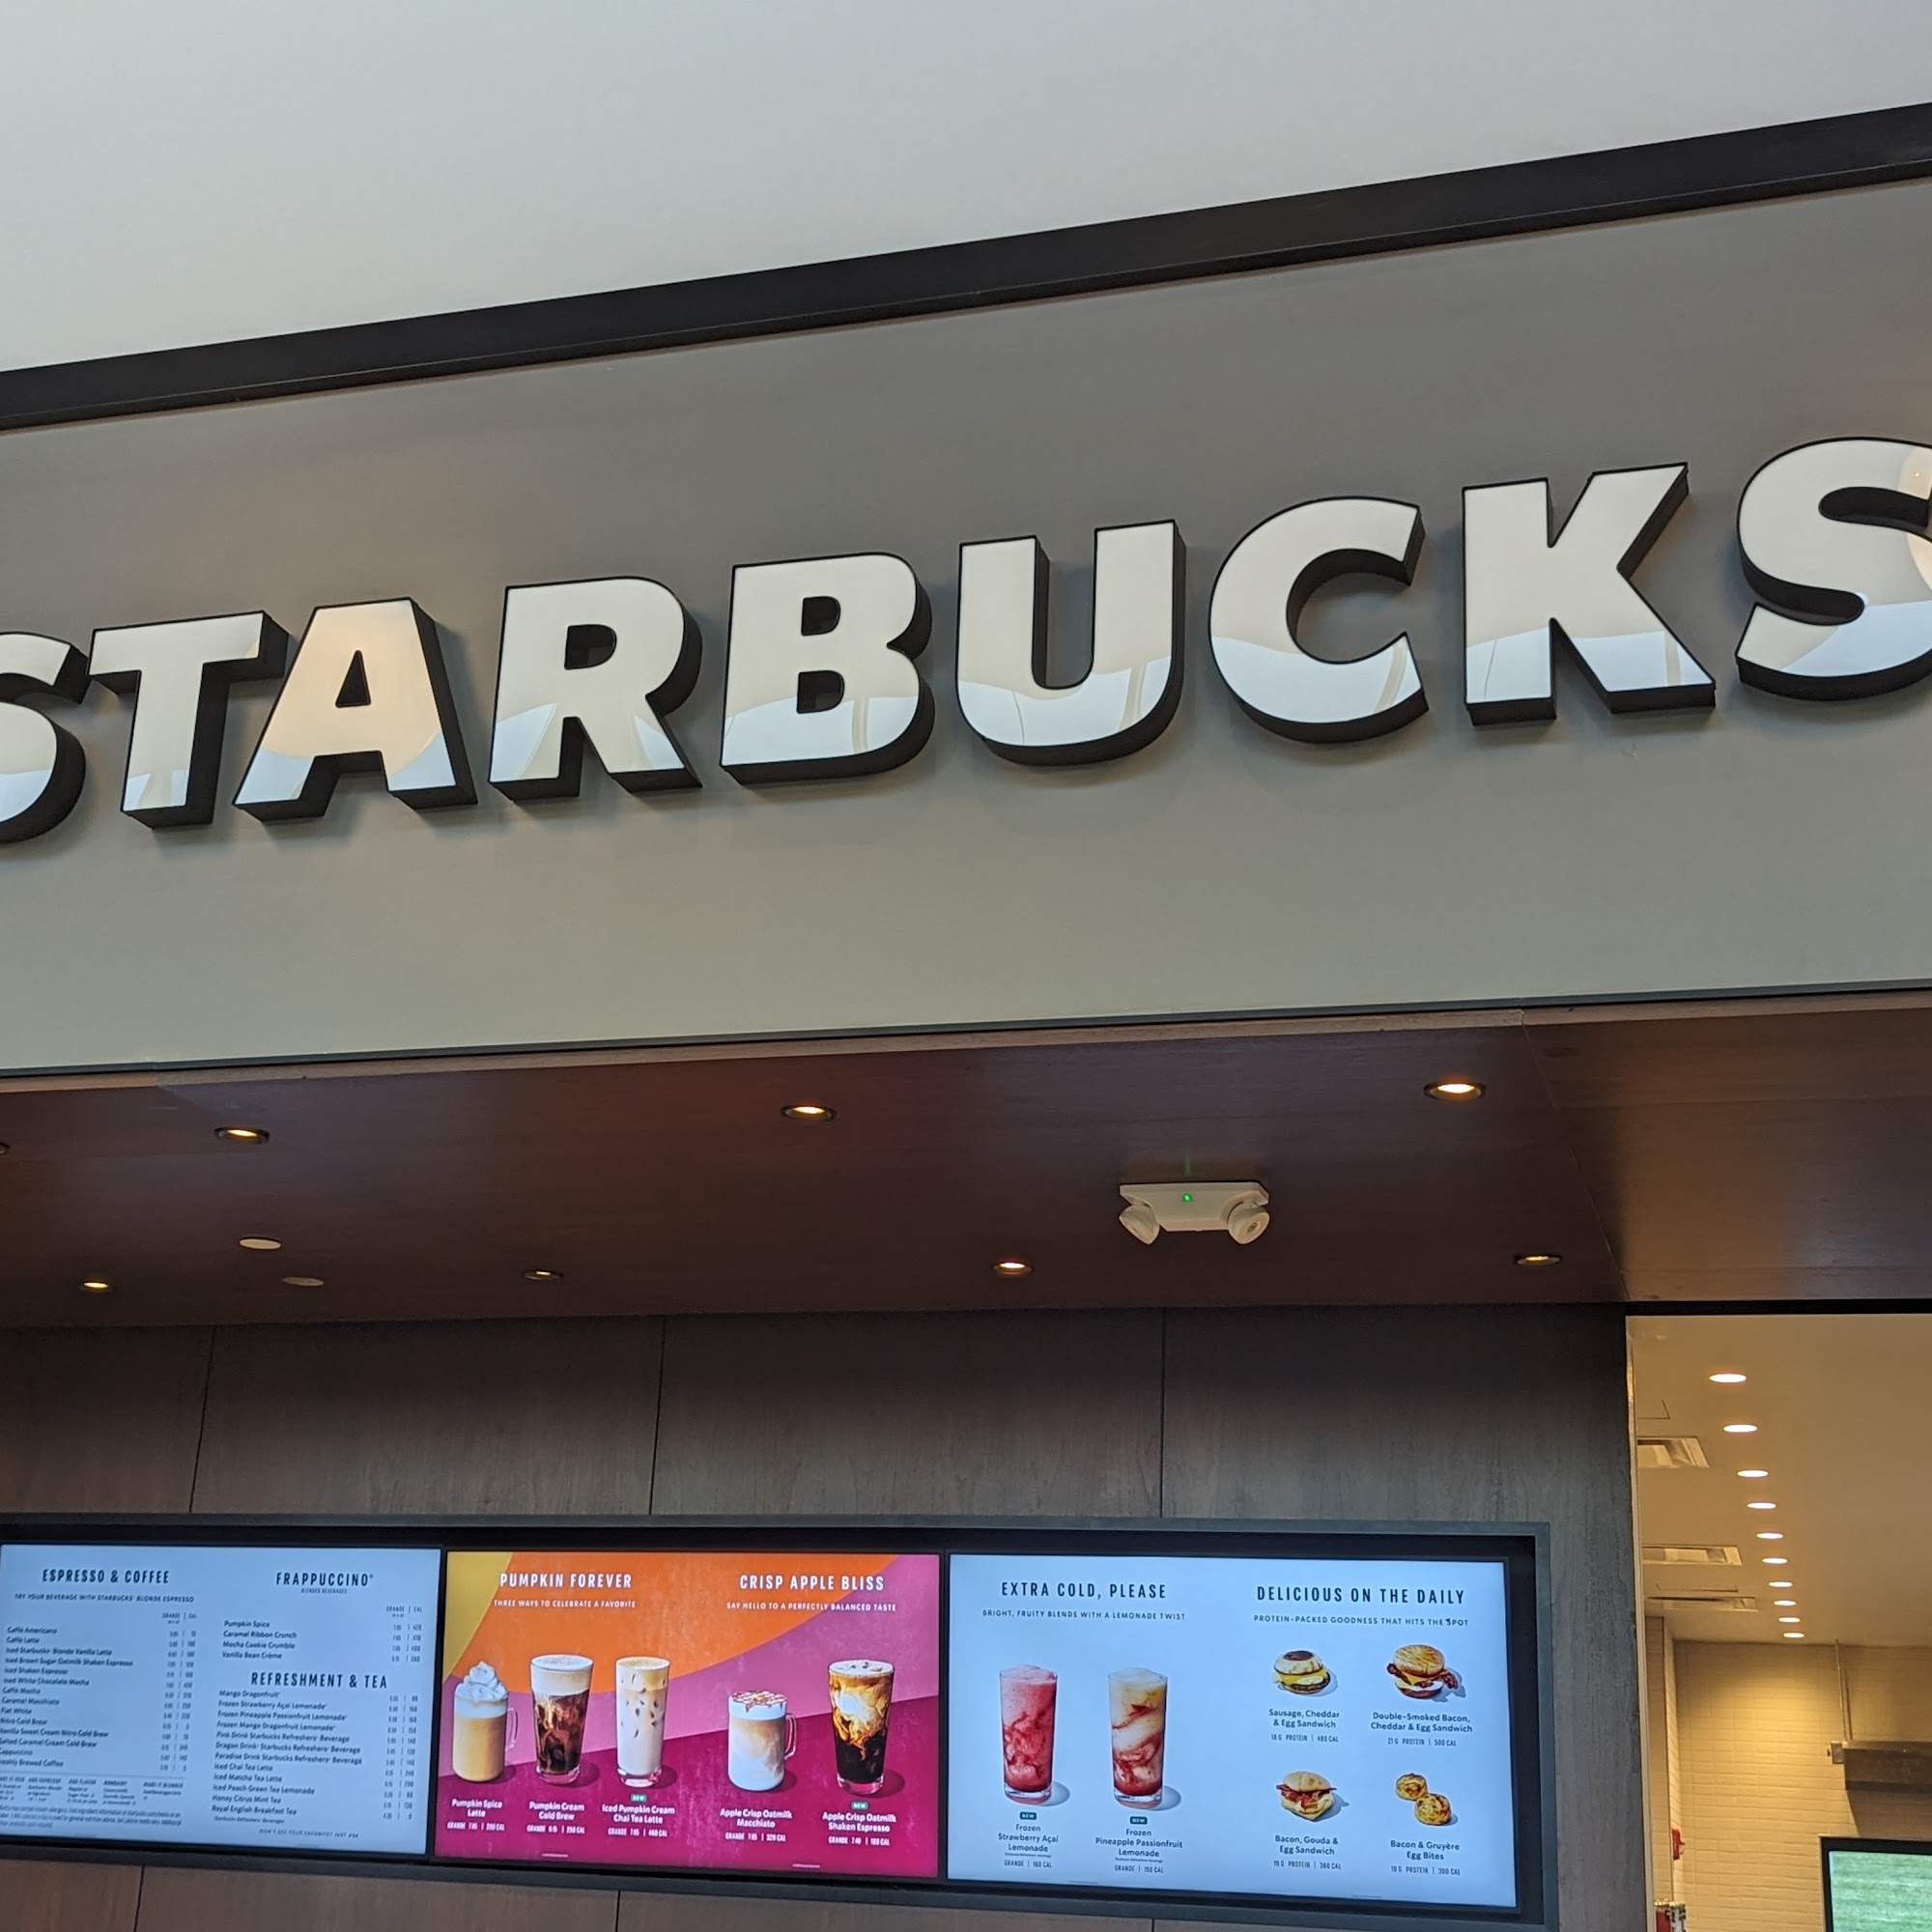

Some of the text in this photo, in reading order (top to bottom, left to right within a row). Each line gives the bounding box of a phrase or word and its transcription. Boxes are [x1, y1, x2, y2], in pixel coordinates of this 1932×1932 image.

[43, 1569, 168, 1583] ESPRESSO & COFFEE
[500, 1573, 631, 1588] PUMPKIN FOREVER
[740, 1575, 883, 1590] CRISP APPLE BLISS
[1002, 1582, 1165, 1599] EXTRA COLD, PLEASE
[1257, 1586, 1463, 1604] DELICIOUS ON THE DAILY
[251, 1672, 386, 1688] REFRESHMENT & TEA
[1269, 1709, 1304, 1718] Sausage,
[1373, 1712, 1470, 1723] Double-Smoked Bacon,
[1281, 1719, 1295, 1728] Egg
[1297, 1719, 1336, 1728] Sandwich
[1371, 1722, 1406, 1730] Cheddar
[1416, 1723, 1431, 1733] Egg
[1433, 1724, 1473, 1732] Sandwich
[452, 1799, 502, 1809] Pumpkin Spice
[529, 1801, 585, 1811] Pumpkin Cream
[468, 1809, 486, 1817] Latte
[618, 1805, 650, 1814] Pumpkin
[651, 1805, 675, 1814] Cream
[720, 1808, 792, 1819] Apple Crisp Oatmilk
[539, 1811, 574, 1820] Cold Brew
[613, 1814, 663, 1823] Chai Tea Latte
[823, 1812, 896, 1822] Apple Crisp Oatmilk
[829, 1822, 890, 1833] Shaken Espresso
[998, 1833, 1040, 1843] Strawberry
[1095, 1837, 1183, 1848] Pineapple Passionfruit
[1275, 1835, 1302, 1844] Bacon,
[1304, 1836, 1330, 1844] Gouda
[1008, 1843, 1048, 1852] Lemonade
[1390, 1840, 1416, 1848] Bacon
[1118, 1848, 1159, 1857] Lemonade
[1280, 1845, 1335, 1855] Egg Sandwich
[1407, 1851, 1444, 1860] Egg Bites
